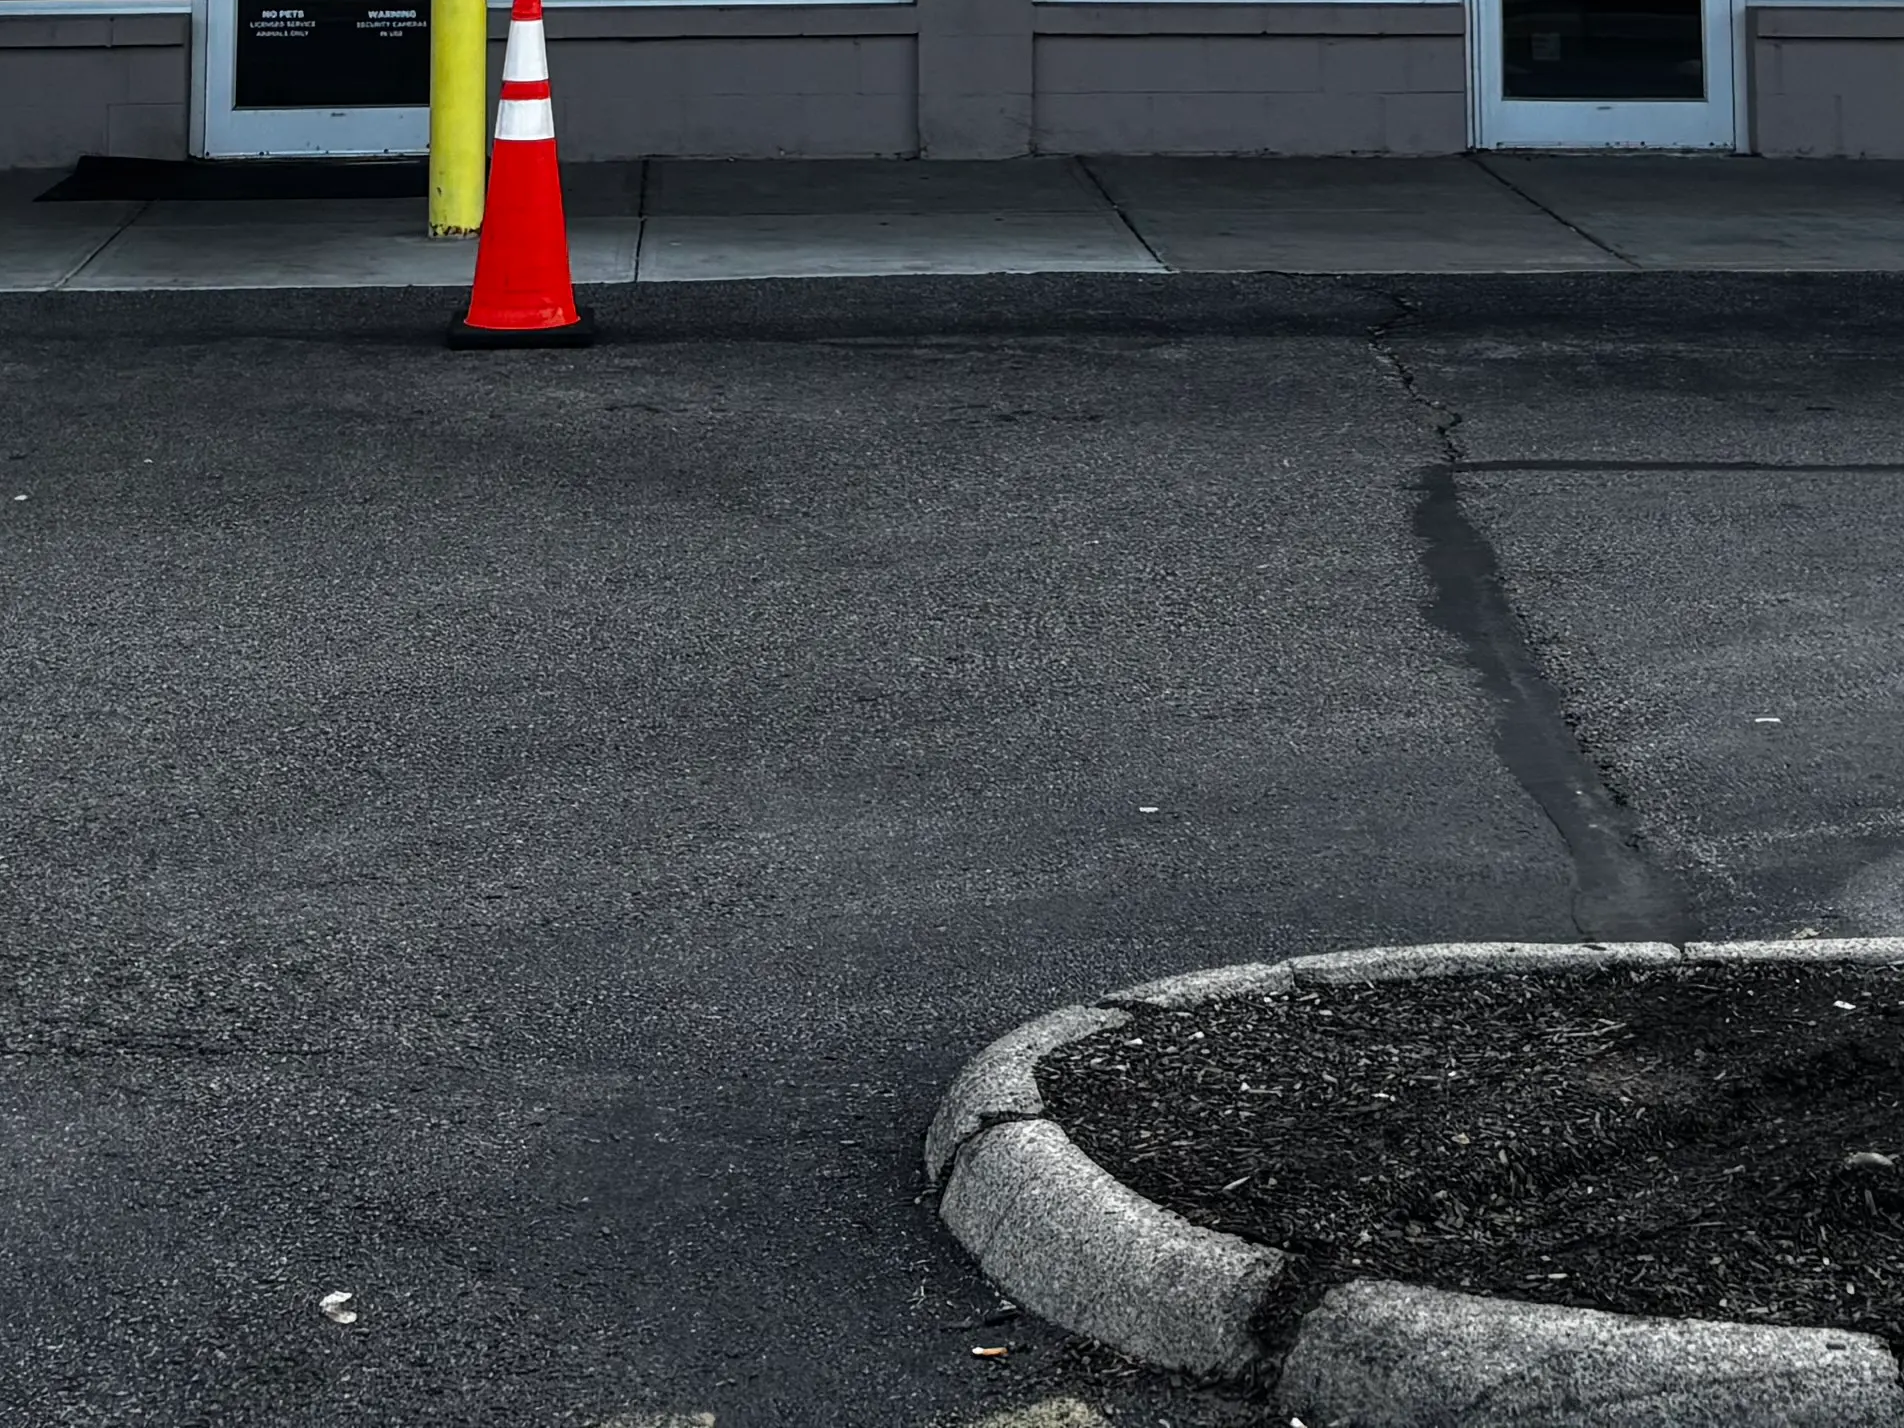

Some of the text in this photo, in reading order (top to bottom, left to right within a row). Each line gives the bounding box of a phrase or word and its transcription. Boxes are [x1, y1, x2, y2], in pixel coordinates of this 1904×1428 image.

[262, 10, 305, 19] NO PETS
[368, 10, 417, 19] WARNING
